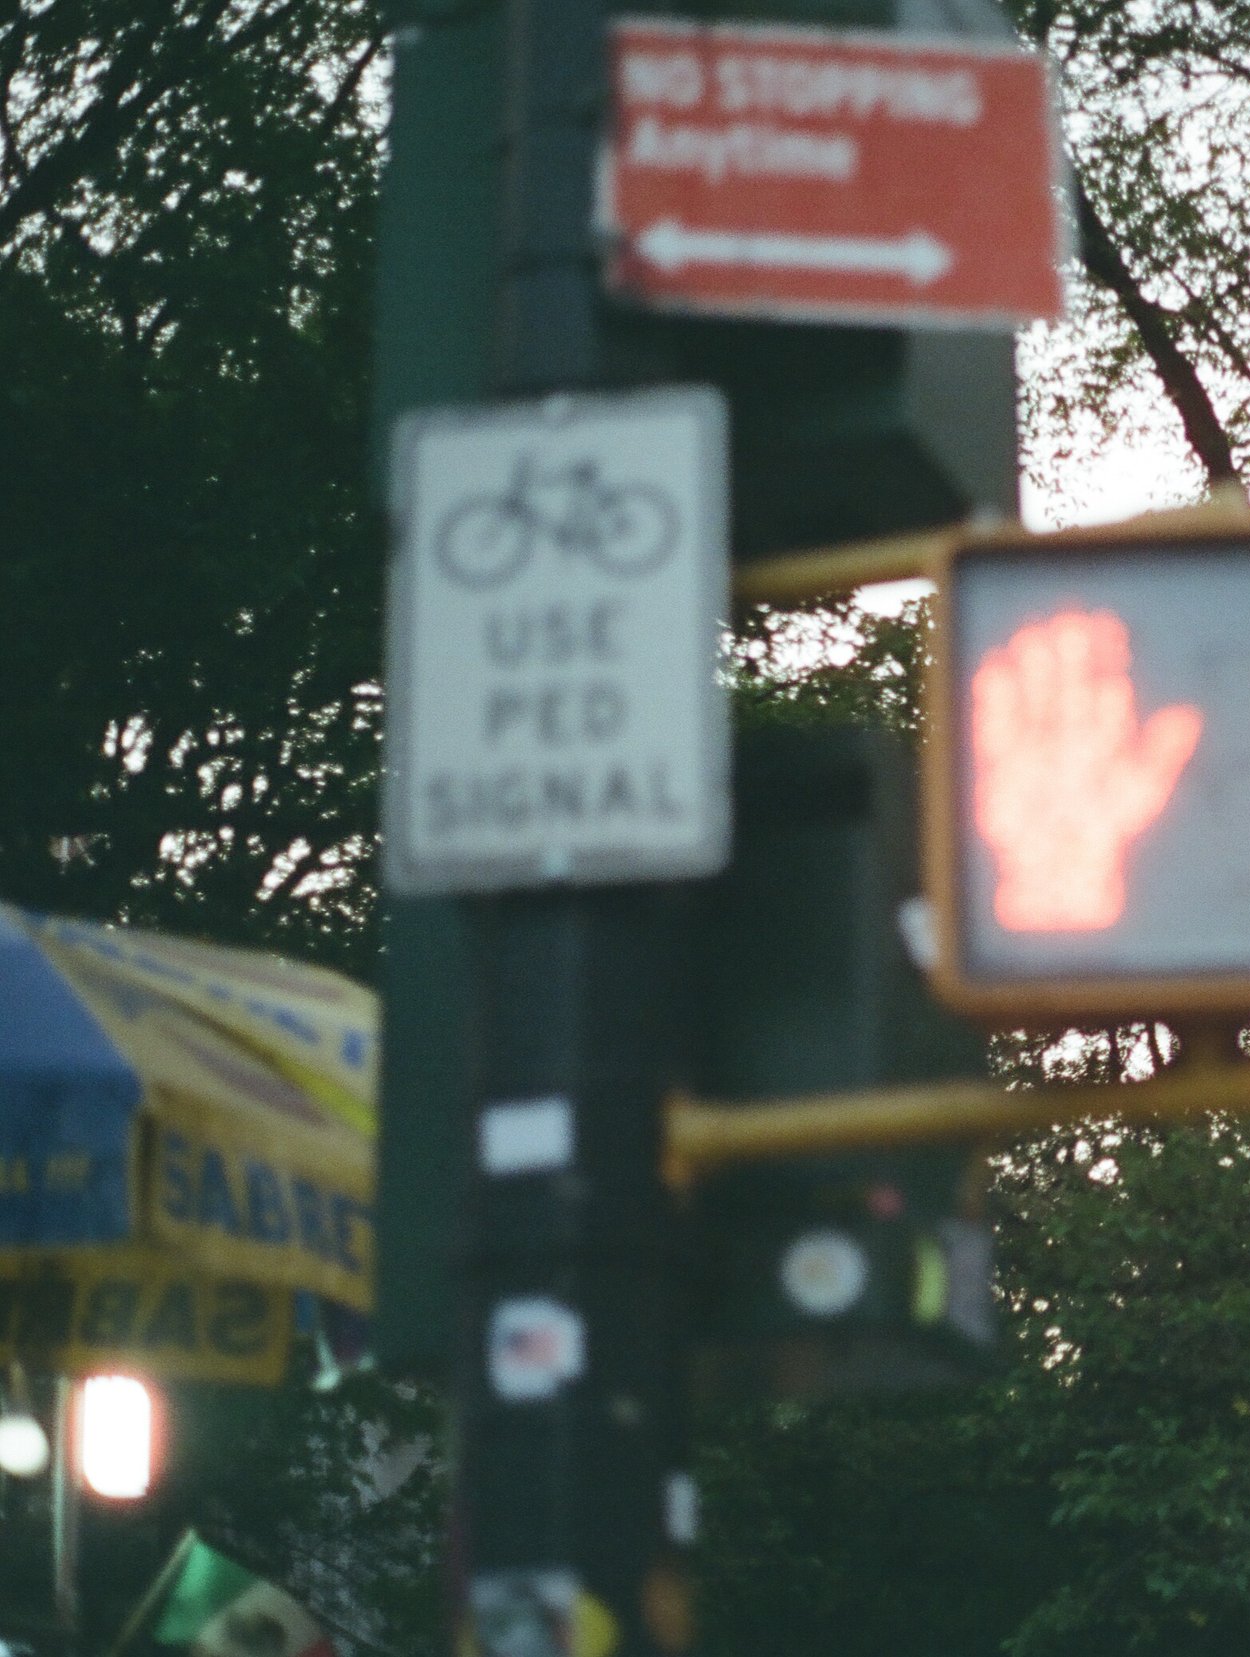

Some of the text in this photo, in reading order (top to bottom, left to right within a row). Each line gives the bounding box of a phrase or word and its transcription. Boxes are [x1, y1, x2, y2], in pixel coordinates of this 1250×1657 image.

[622, 54, 982, 127] NO STOPPING
[631, 119, 854, 183] Anytime
[485, 600, 621, 667] USE
[487, 682, 627, 748] PED
[425, 761, 690, 835] SIGNAL
